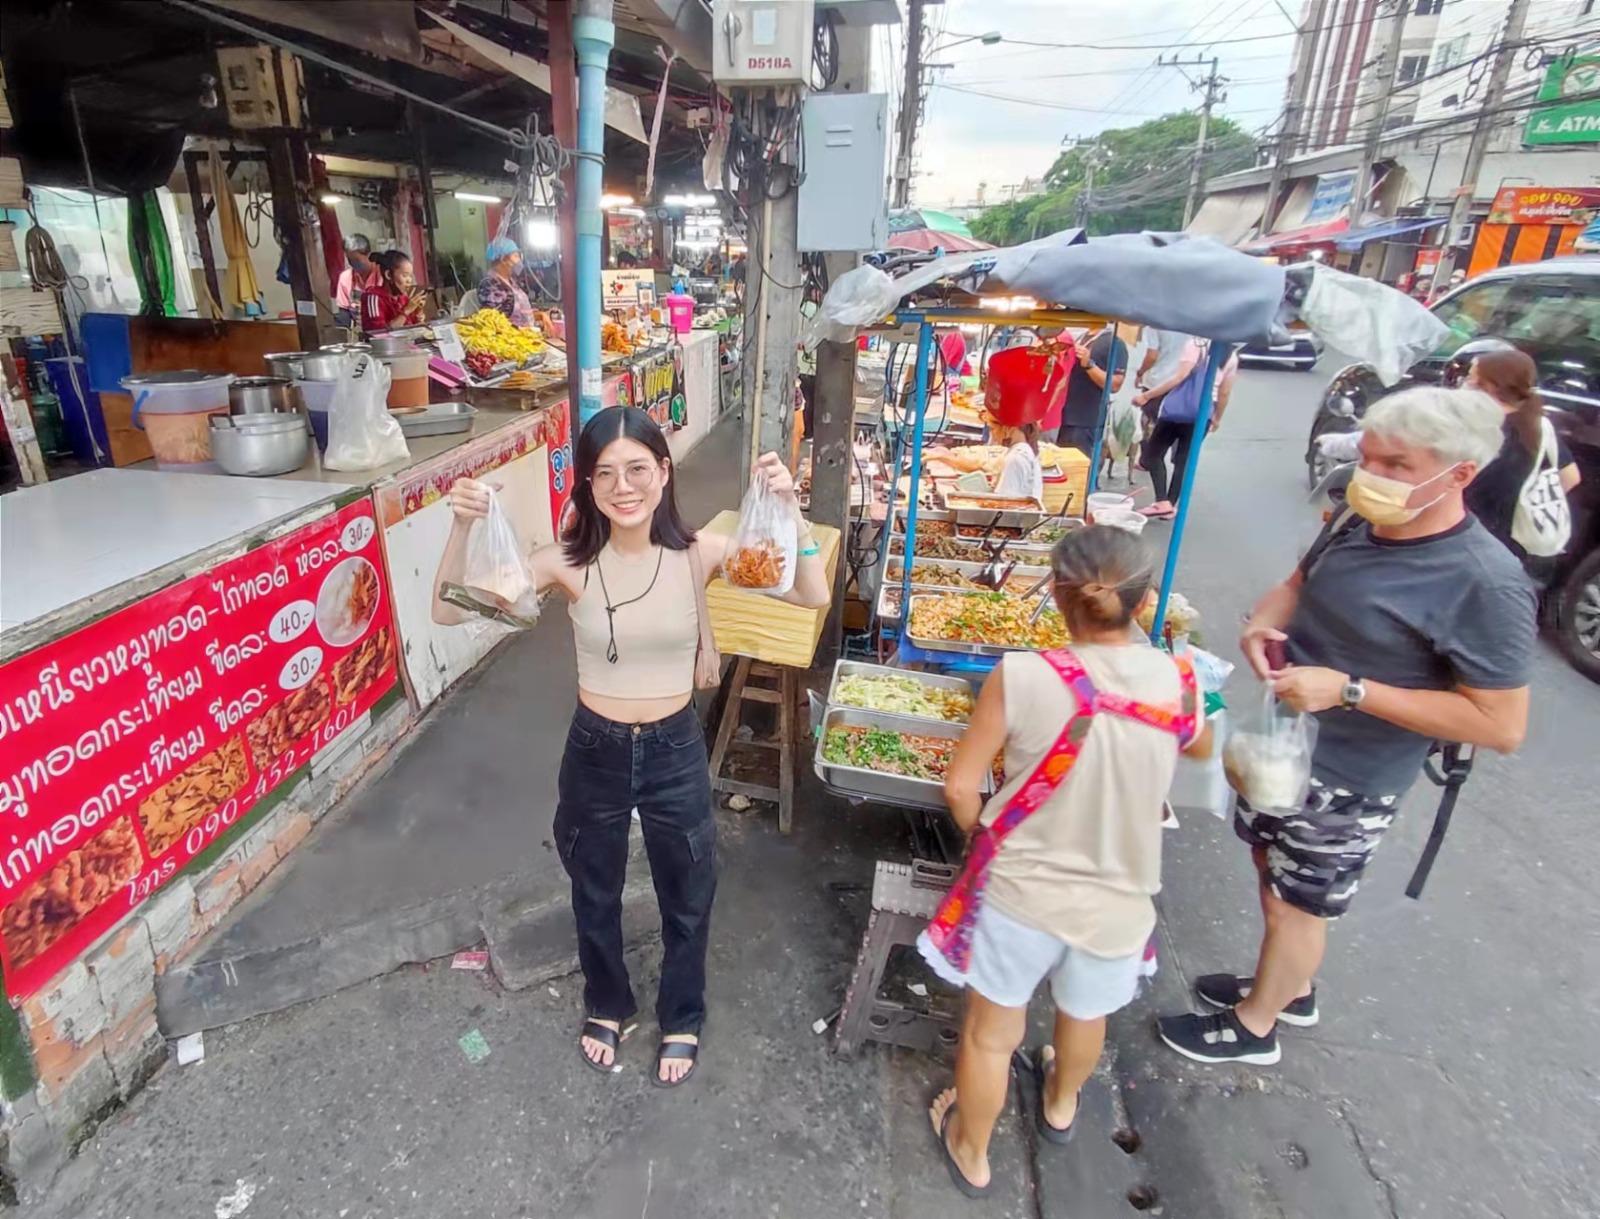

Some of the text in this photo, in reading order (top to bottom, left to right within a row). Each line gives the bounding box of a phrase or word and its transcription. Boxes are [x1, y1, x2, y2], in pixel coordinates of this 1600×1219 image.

[748, 57, 792, 69] D518A
[1557, 116, 1600, 132] ATM
[206, 637, 268, 676] ขีดละ
[209, 684, 268, 733] ขีดละ
[187, 701, 357, 854] 090-452-1601
